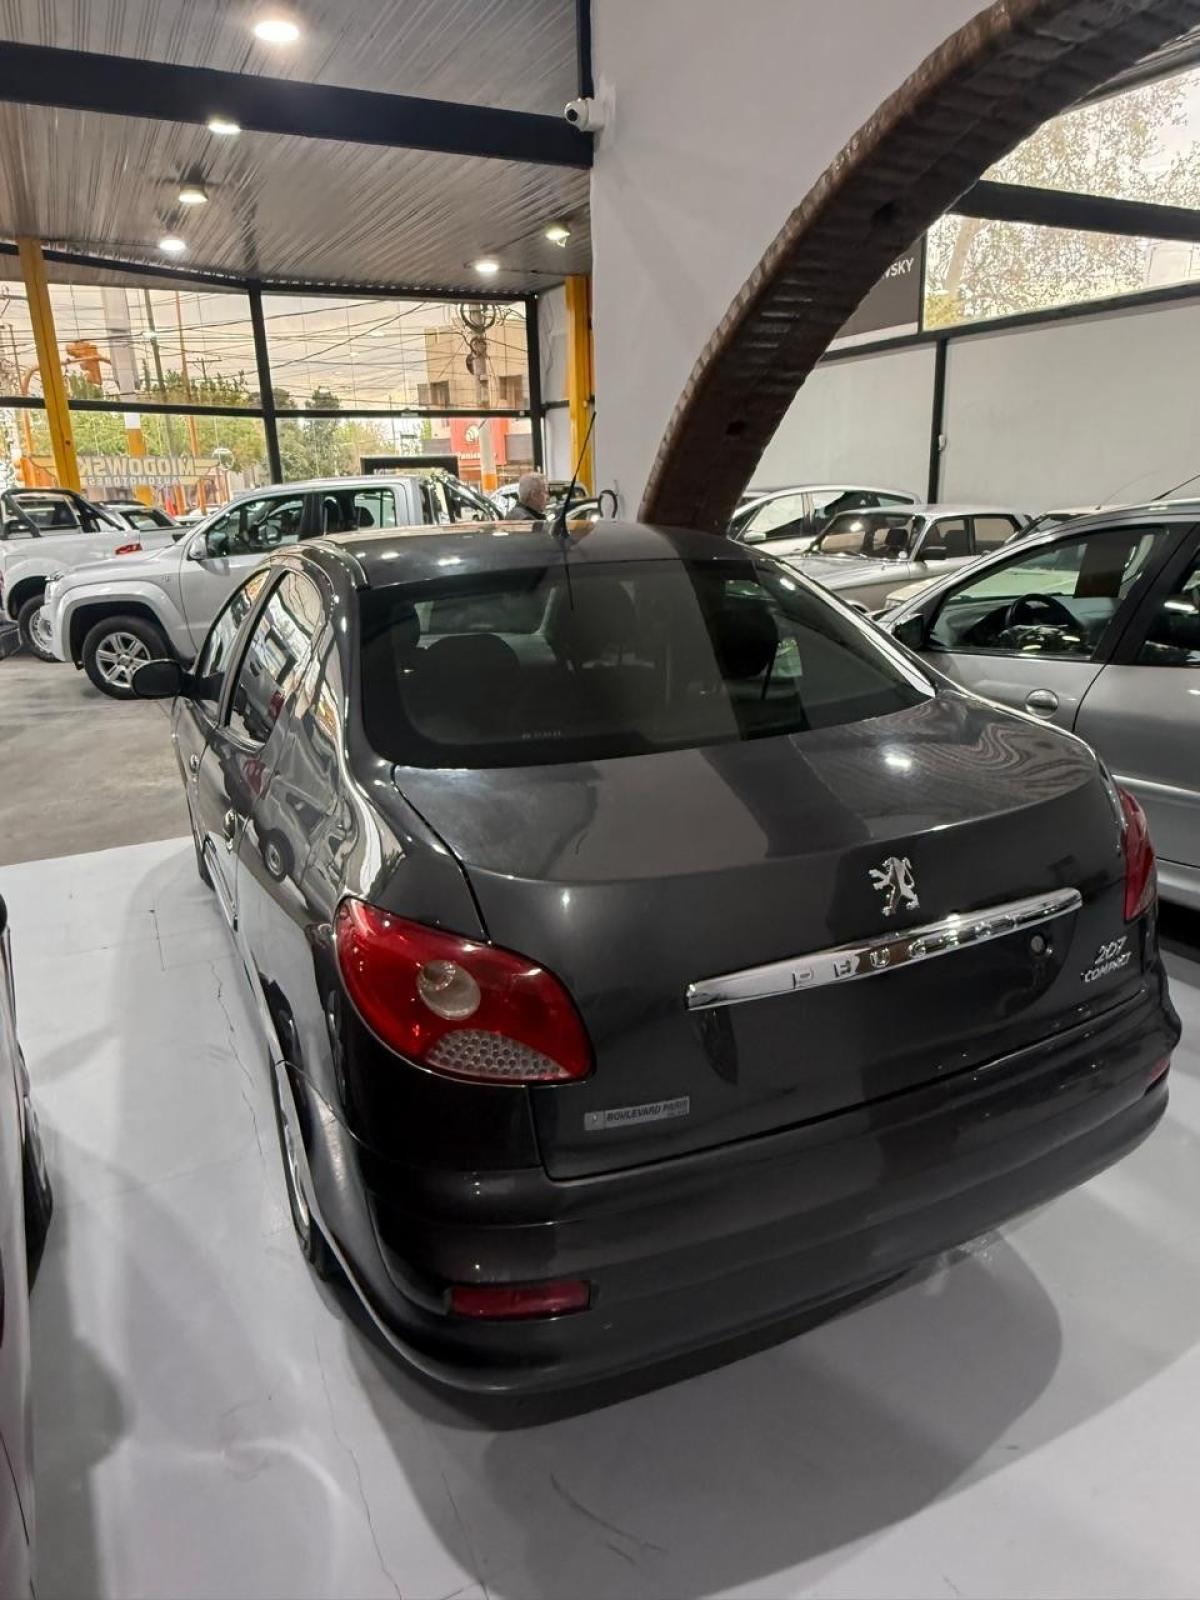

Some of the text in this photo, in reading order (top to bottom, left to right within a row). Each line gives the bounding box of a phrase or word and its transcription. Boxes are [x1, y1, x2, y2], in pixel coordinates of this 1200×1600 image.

[792, 914, 1016, 989] PEUGEOT
[1095, 936, 1127, 964] 207
[607, 1105, 660, 1121] BOULEVARD
